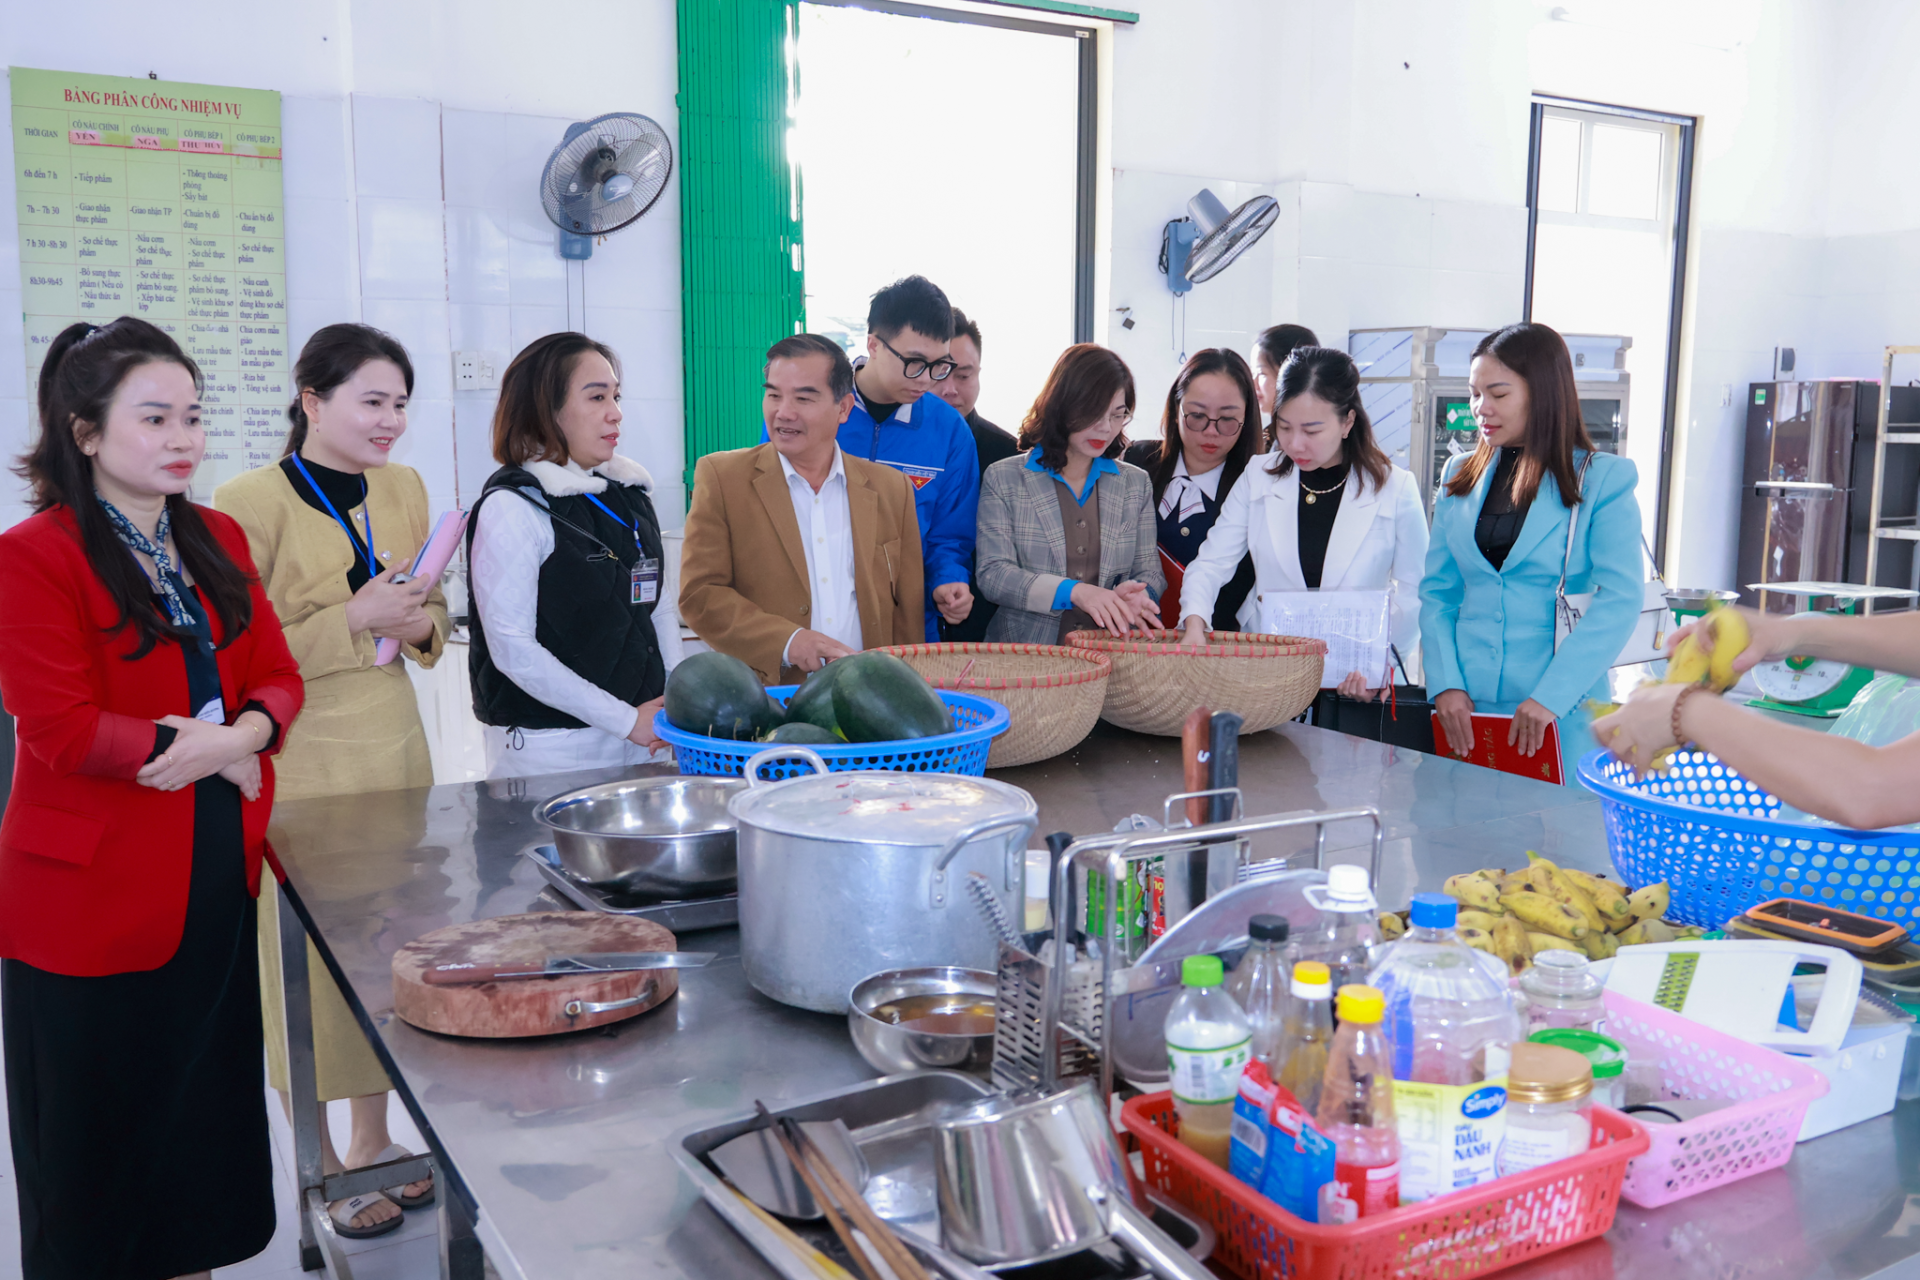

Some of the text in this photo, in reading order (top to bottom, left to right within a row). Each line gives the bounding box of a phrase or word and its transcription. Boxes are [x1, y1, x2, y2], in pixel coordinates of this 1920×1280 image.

[64, 86, 242, 119] BẢNG PHÂN CÔNG NHIỆM VỤ
[41, 129, 58, 138] GIAN
[1465, 1092, 1506, 1113] Simply
